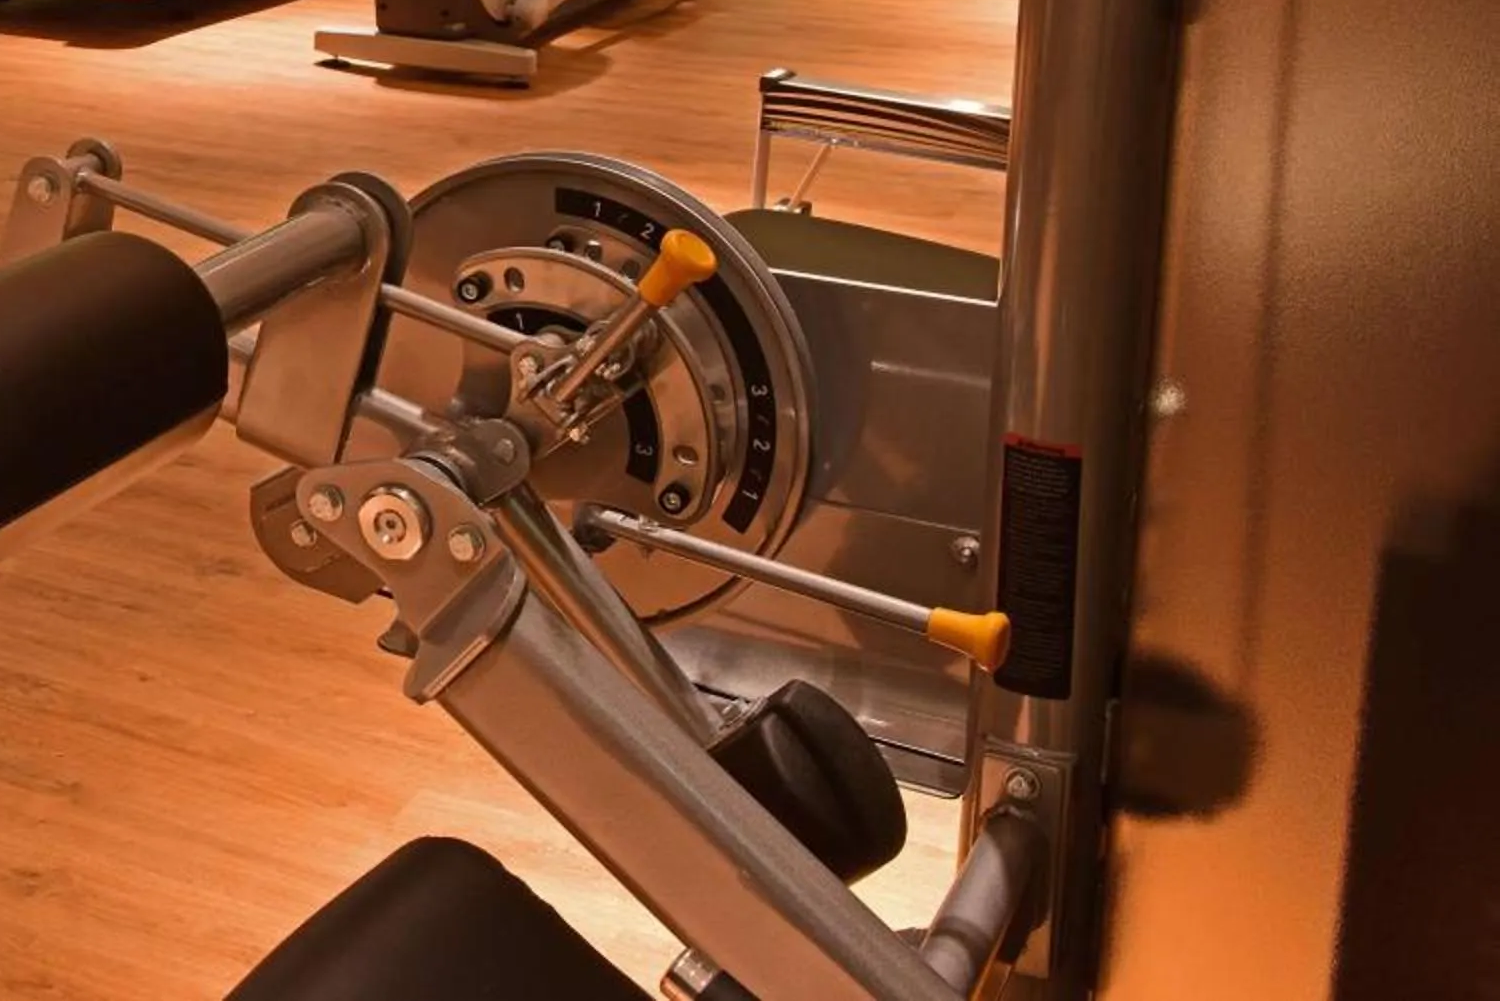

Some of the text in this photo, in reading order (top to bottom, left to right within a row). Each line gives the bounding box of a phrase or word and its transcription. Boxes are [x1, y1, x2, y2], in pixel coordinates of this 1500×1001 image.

[594, 202, 655, 239] 1 2
[742, 384, 771, 500] 3 2 1
